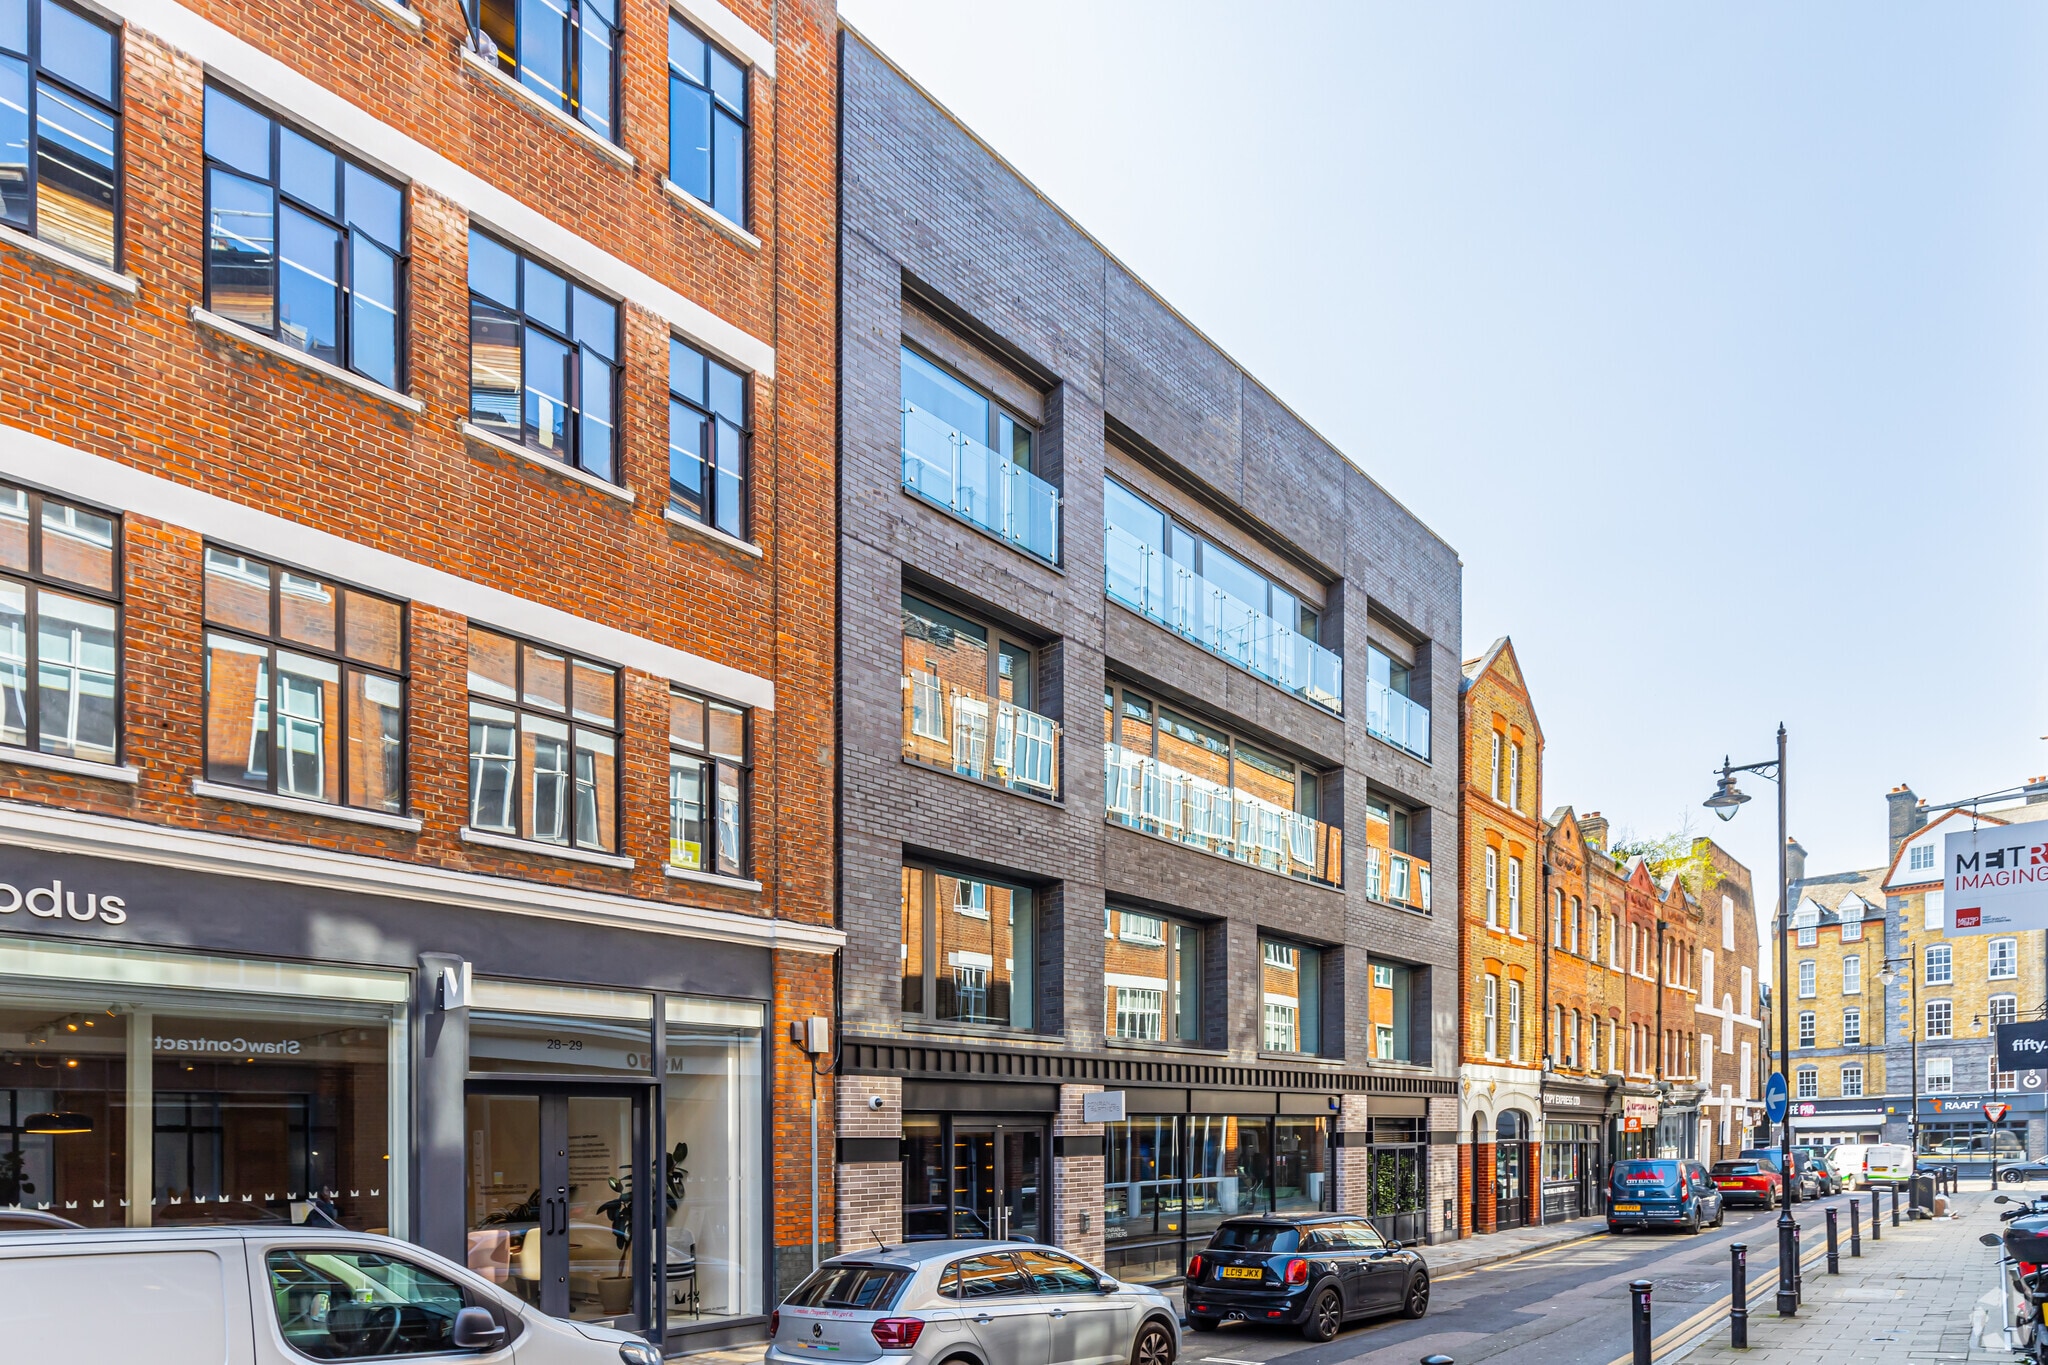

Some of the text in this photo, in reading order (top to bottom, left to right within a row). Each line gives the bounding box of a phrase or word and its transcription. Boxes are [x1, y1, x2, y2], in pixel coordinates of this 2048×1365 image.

[1956, 866, 2048, 891] IMAGING
[0, 880, 127, 925] odus
[1543, 1093, 1555, 1104] COPY
[1555, 1094, 1573, 1105] EXPRESS
[1944, 1100, 1981, 1111] RAAFT
[1225, 1268, 1260, 1278] LC19 JKX
